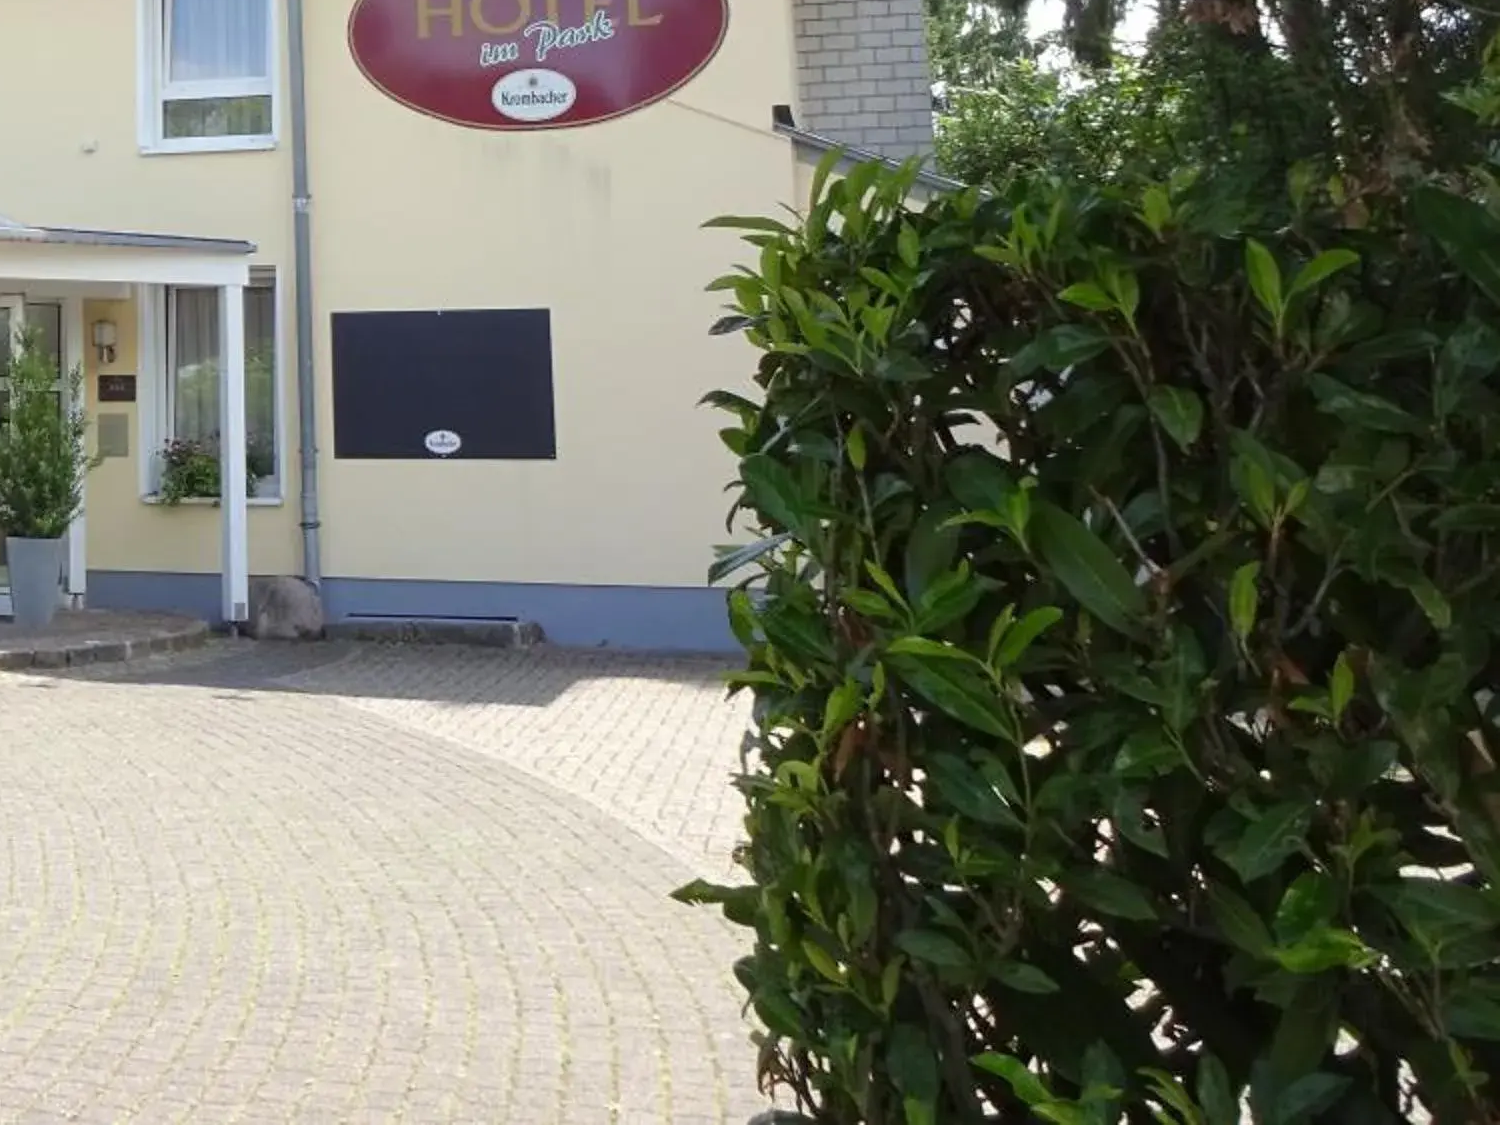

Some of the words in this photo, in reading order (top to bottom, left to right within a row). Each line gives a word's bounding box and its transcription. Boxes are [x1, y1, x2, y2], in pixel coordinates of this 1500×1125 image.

[480, 42, 519, 67] im
[524, 10, 615, 62] Park
[501, 90, 569, 106] Krombacher
